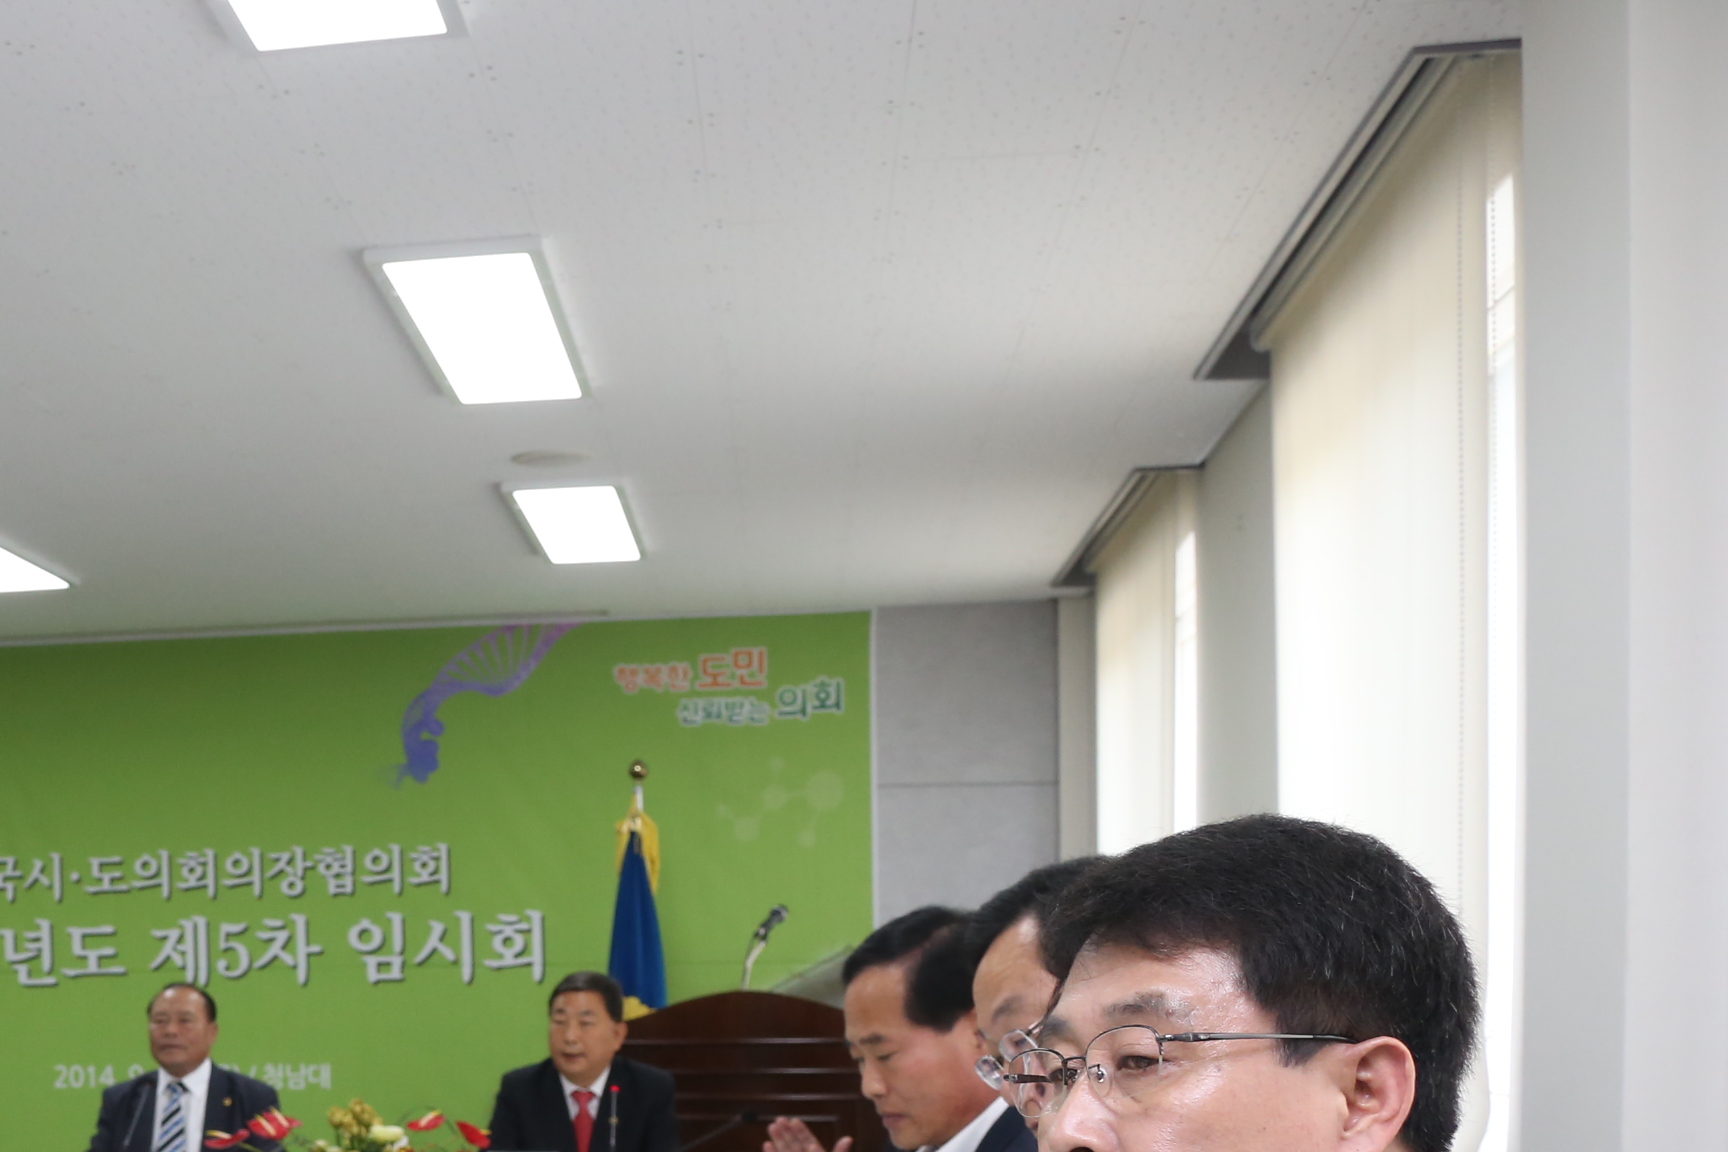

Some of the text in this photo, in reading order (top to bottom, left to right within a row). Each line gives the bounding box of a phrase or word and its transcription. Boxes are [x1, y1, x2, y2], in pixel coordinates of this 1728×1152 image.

[695, 647, 768, 689] 도민
[776, 678, 844, 719] 의회
[150, 912, 324, 987] 제5차
[347, 909, 546, 985] 임시회
